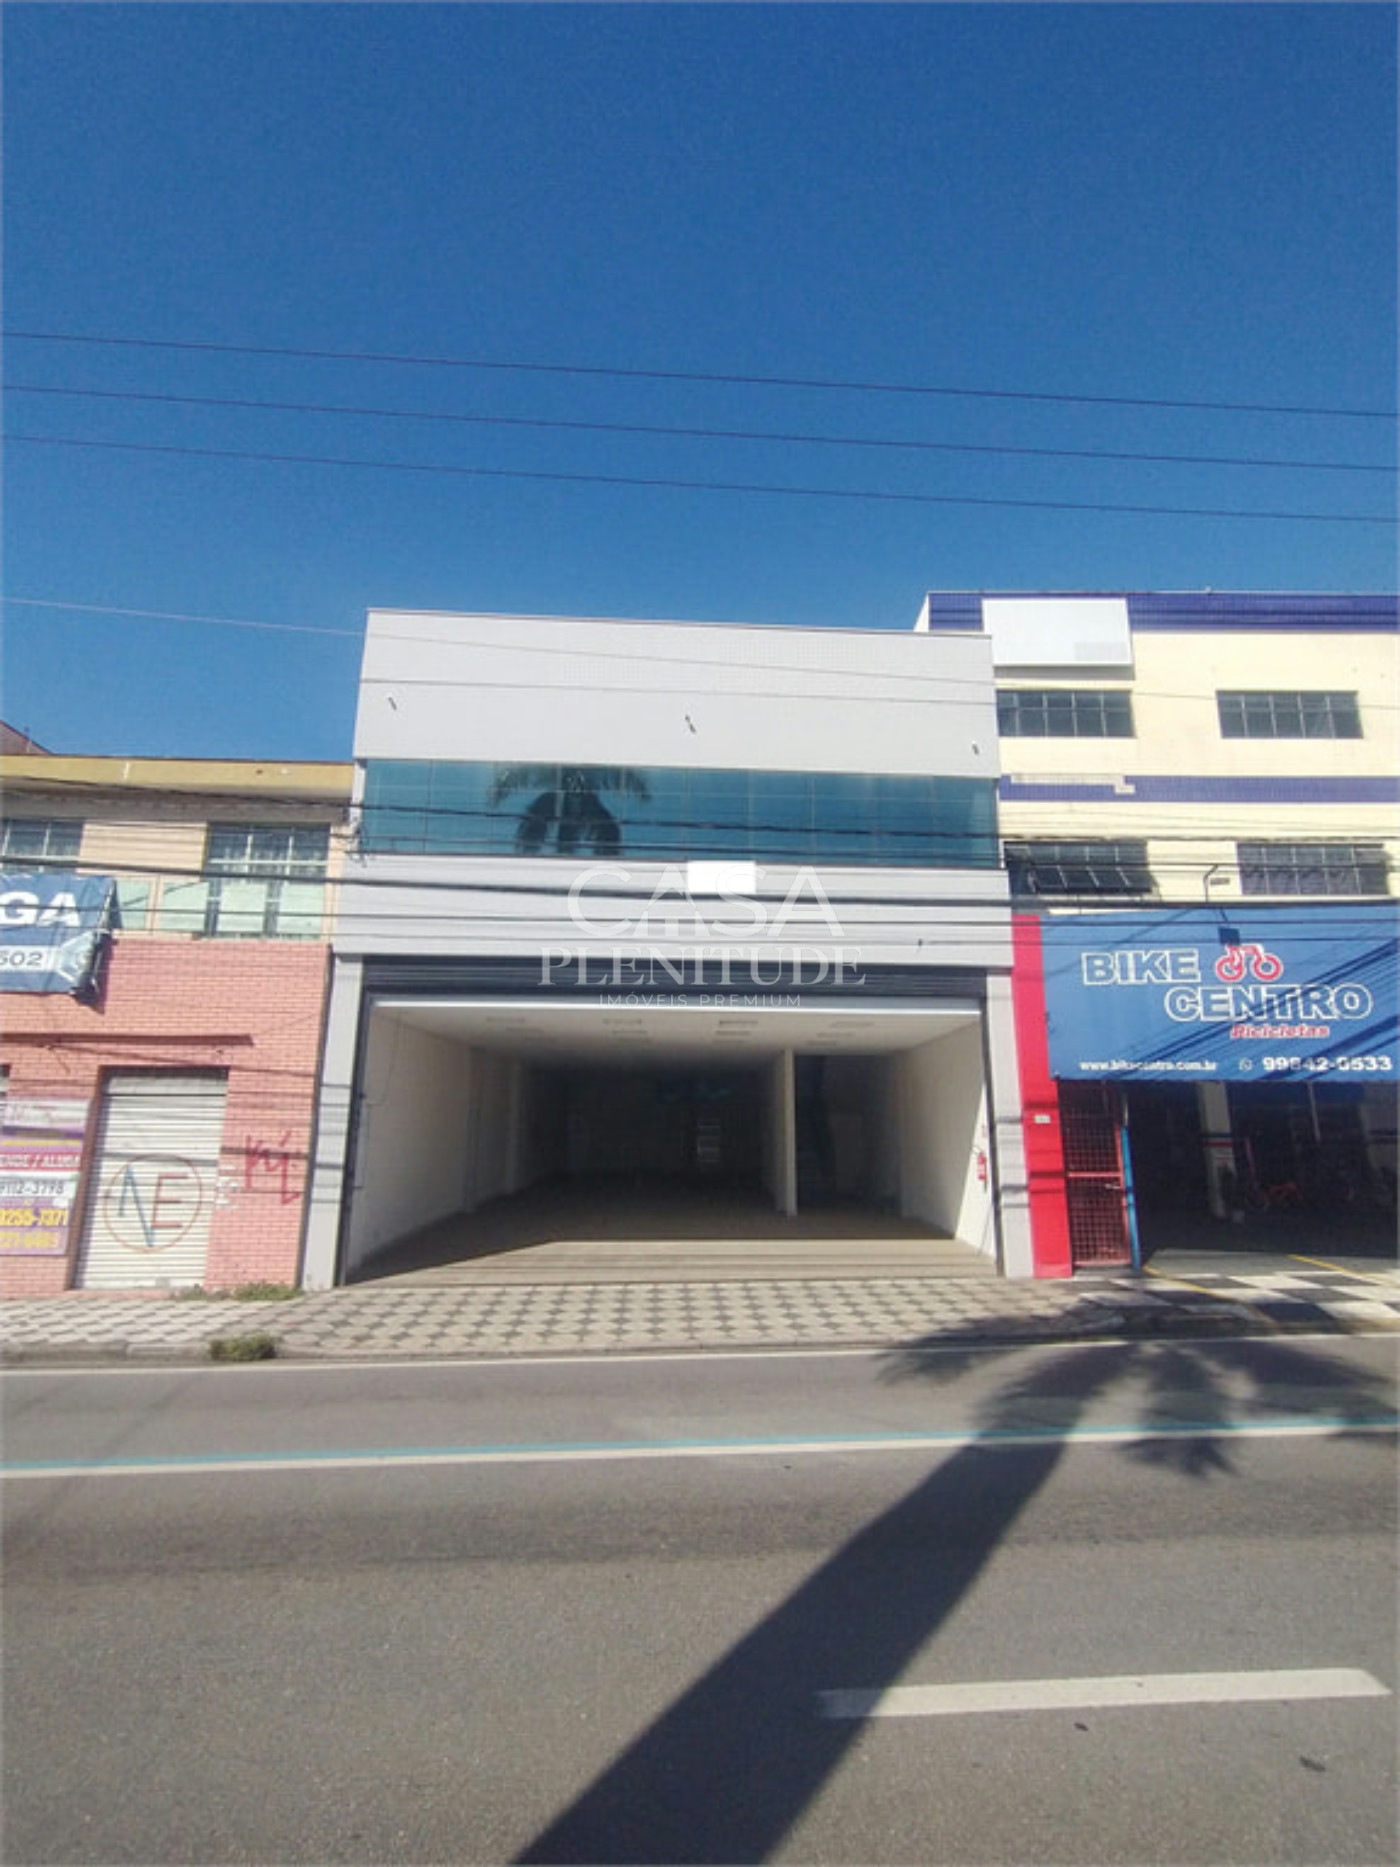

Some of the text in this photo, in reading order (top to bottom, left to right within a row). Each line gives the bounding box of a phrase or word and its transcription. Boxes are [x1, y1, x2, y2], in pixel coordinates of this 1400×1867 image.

[1081, 947, 1201, 986] BIKE
[1164, 983, 1374, 1022] CENTRO
[1230, 1023, 1330, 1039] Bicicletas
